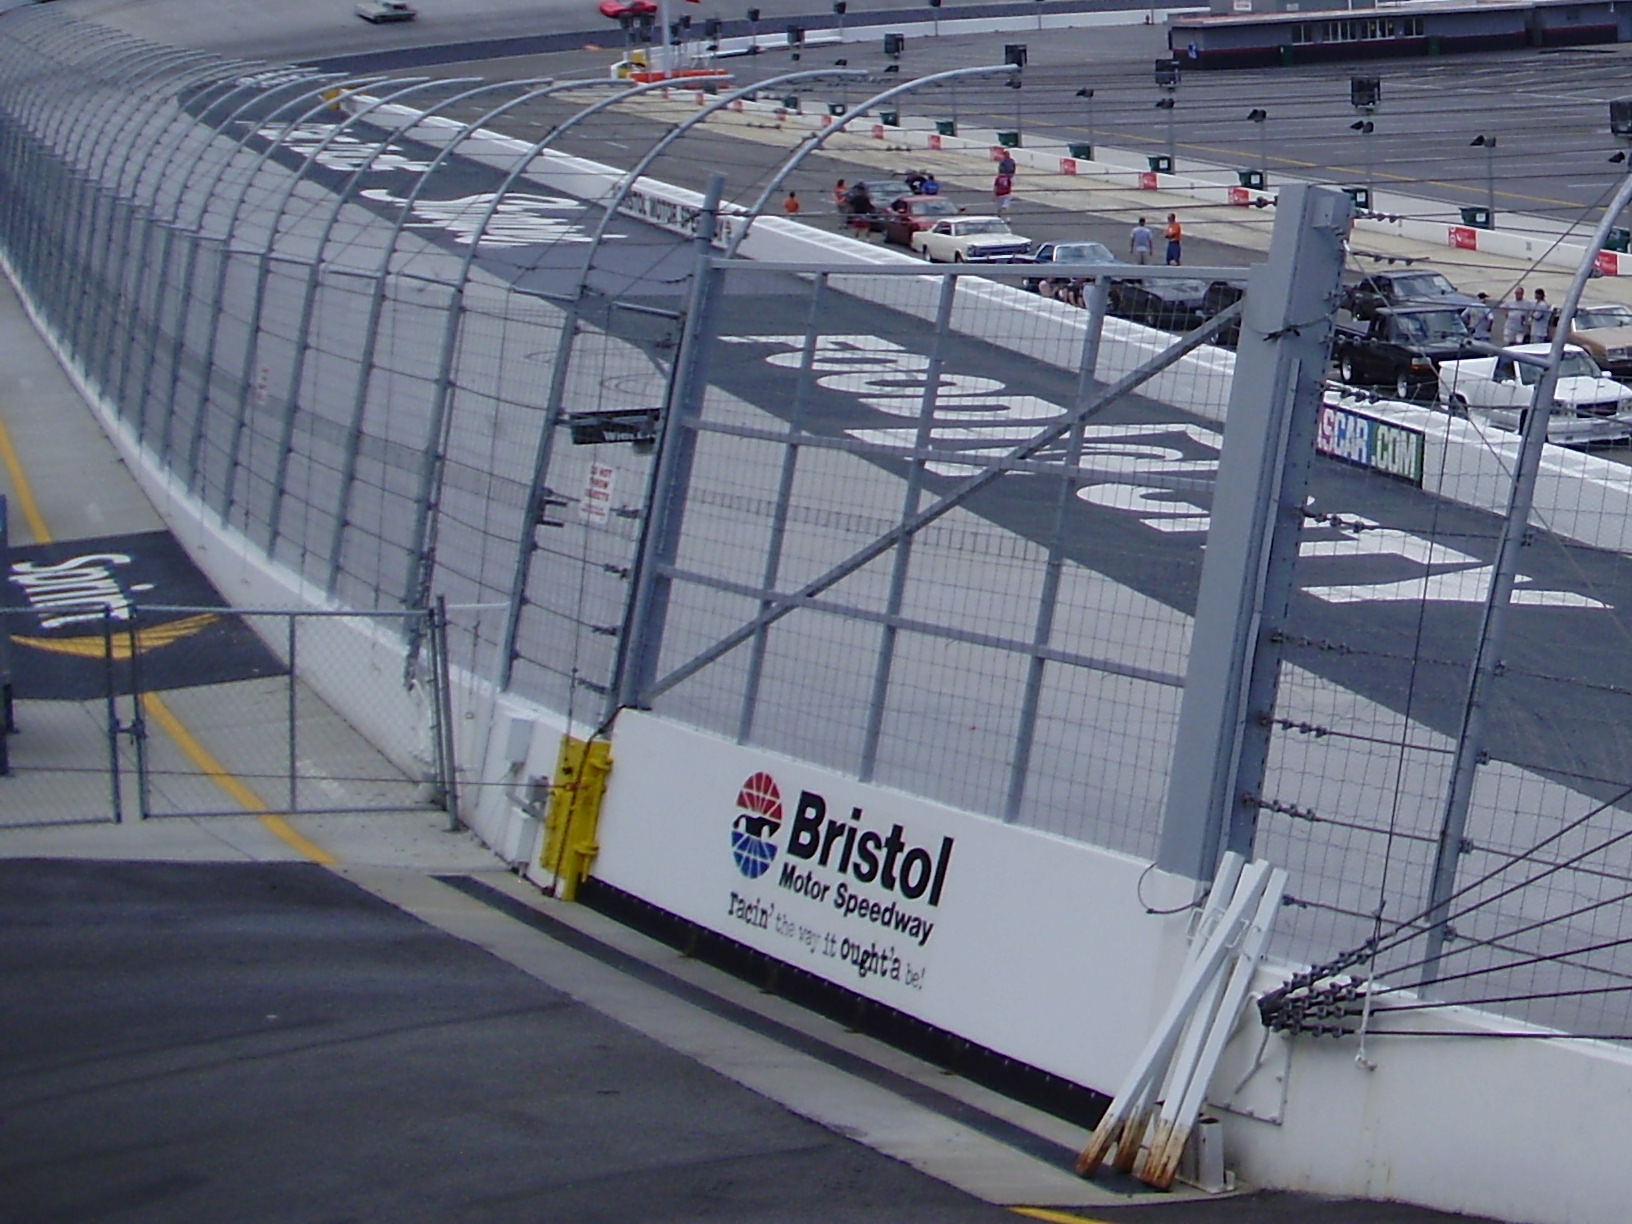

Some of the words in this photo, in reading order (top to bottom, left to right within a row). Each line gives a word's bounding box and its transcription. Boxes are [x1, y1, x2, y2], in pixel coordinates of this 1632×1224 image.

[786, 789, 955, 908] Bristol
[727, 891, 775, 930] racin'
[776, 913, 796, 939] the
[798, 926, 821, 954] way
[822, 932, 837, 957] it
[839, 936, 902, 980] ought'a
[778, 862, 831, 903] Motor
[833, 881, 934, 947] Speedway
